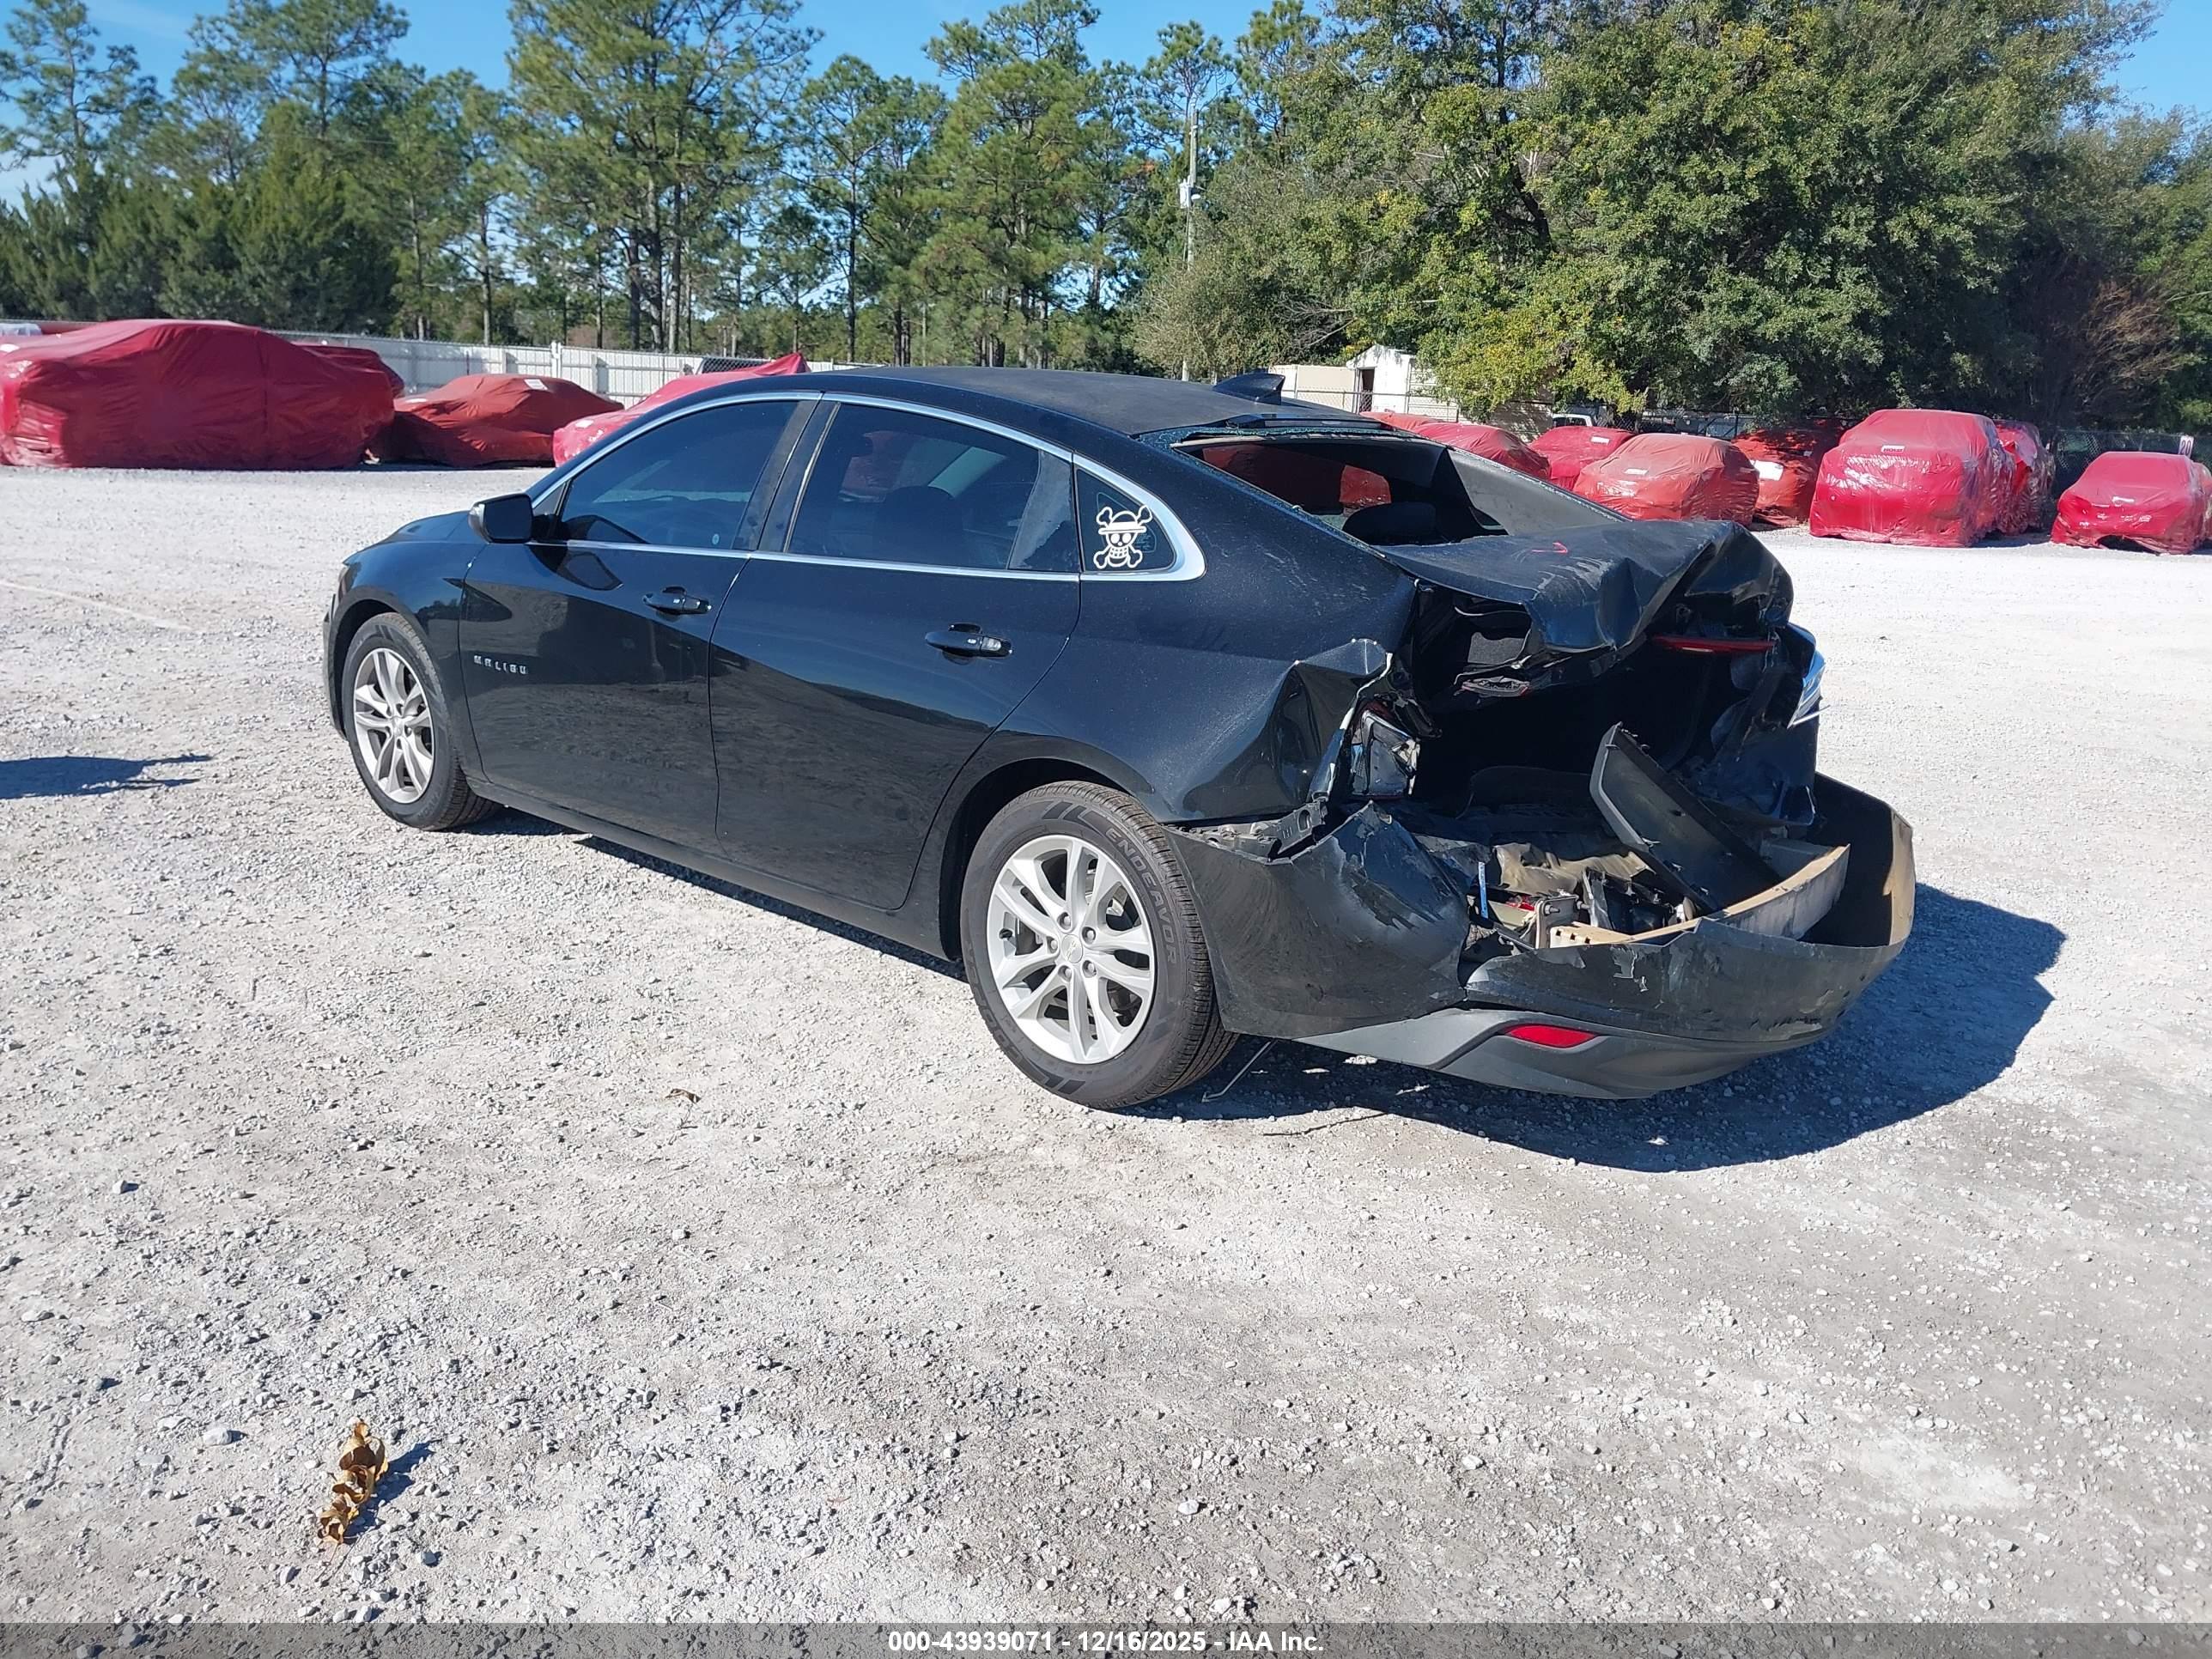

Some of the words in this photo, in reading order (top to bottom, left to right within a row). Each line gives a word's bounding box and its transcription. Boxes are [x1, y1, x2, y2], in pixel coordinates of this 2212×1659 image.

[2180, 440, 2191, 455] 20
[473, 655, 526, 675] MALIBU
[1105, 826, 1177, 964] ENDEAVOR
